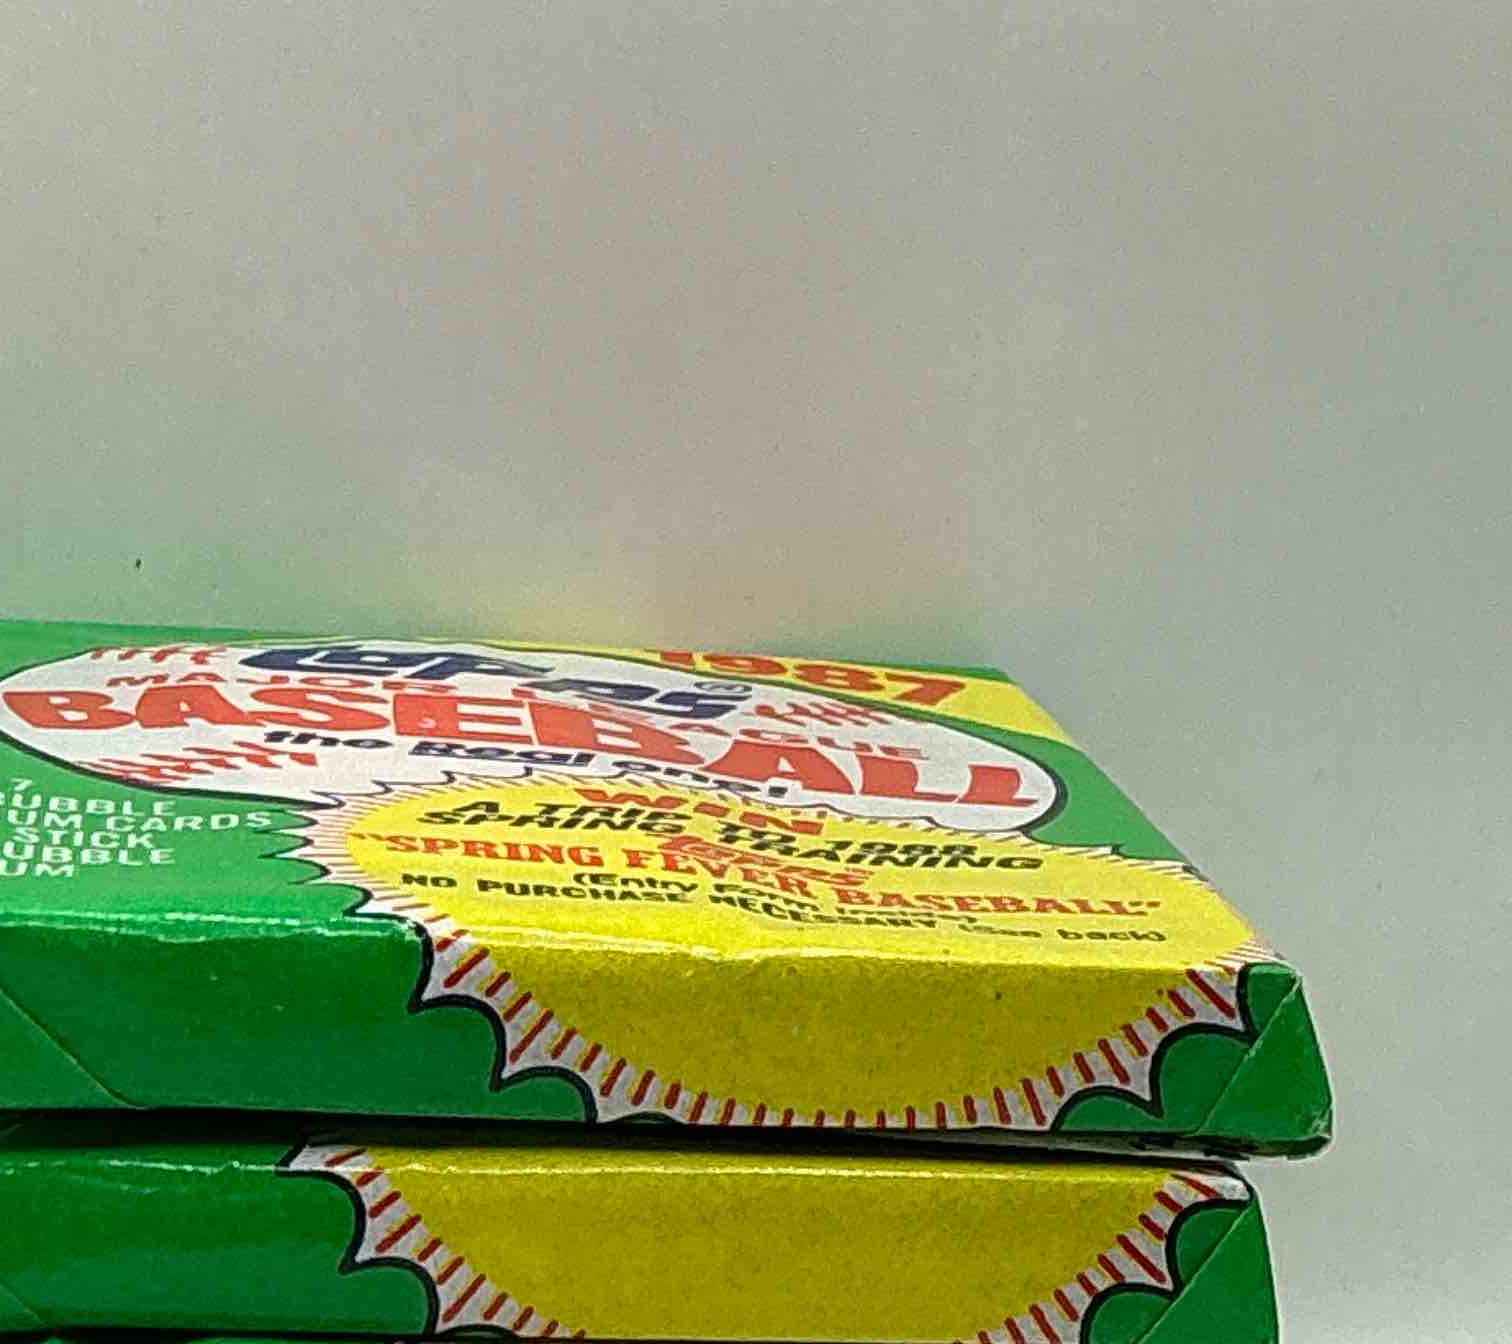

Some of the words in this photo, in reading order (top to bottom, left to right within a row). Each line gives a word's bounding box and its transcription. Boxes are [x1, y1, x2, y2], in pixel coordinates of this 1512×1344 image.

[645, 649, 966, 706] 1987
[2, 683, 1039, 807] BASEBALL
[105, 811, 274, 832] CARDS
[575, 787, 825, 836] WIN
[13, 825, 155, 849] STICK
[401, 872, 458, 889] NO
[477, 877, 692, 903] PURCHASE
